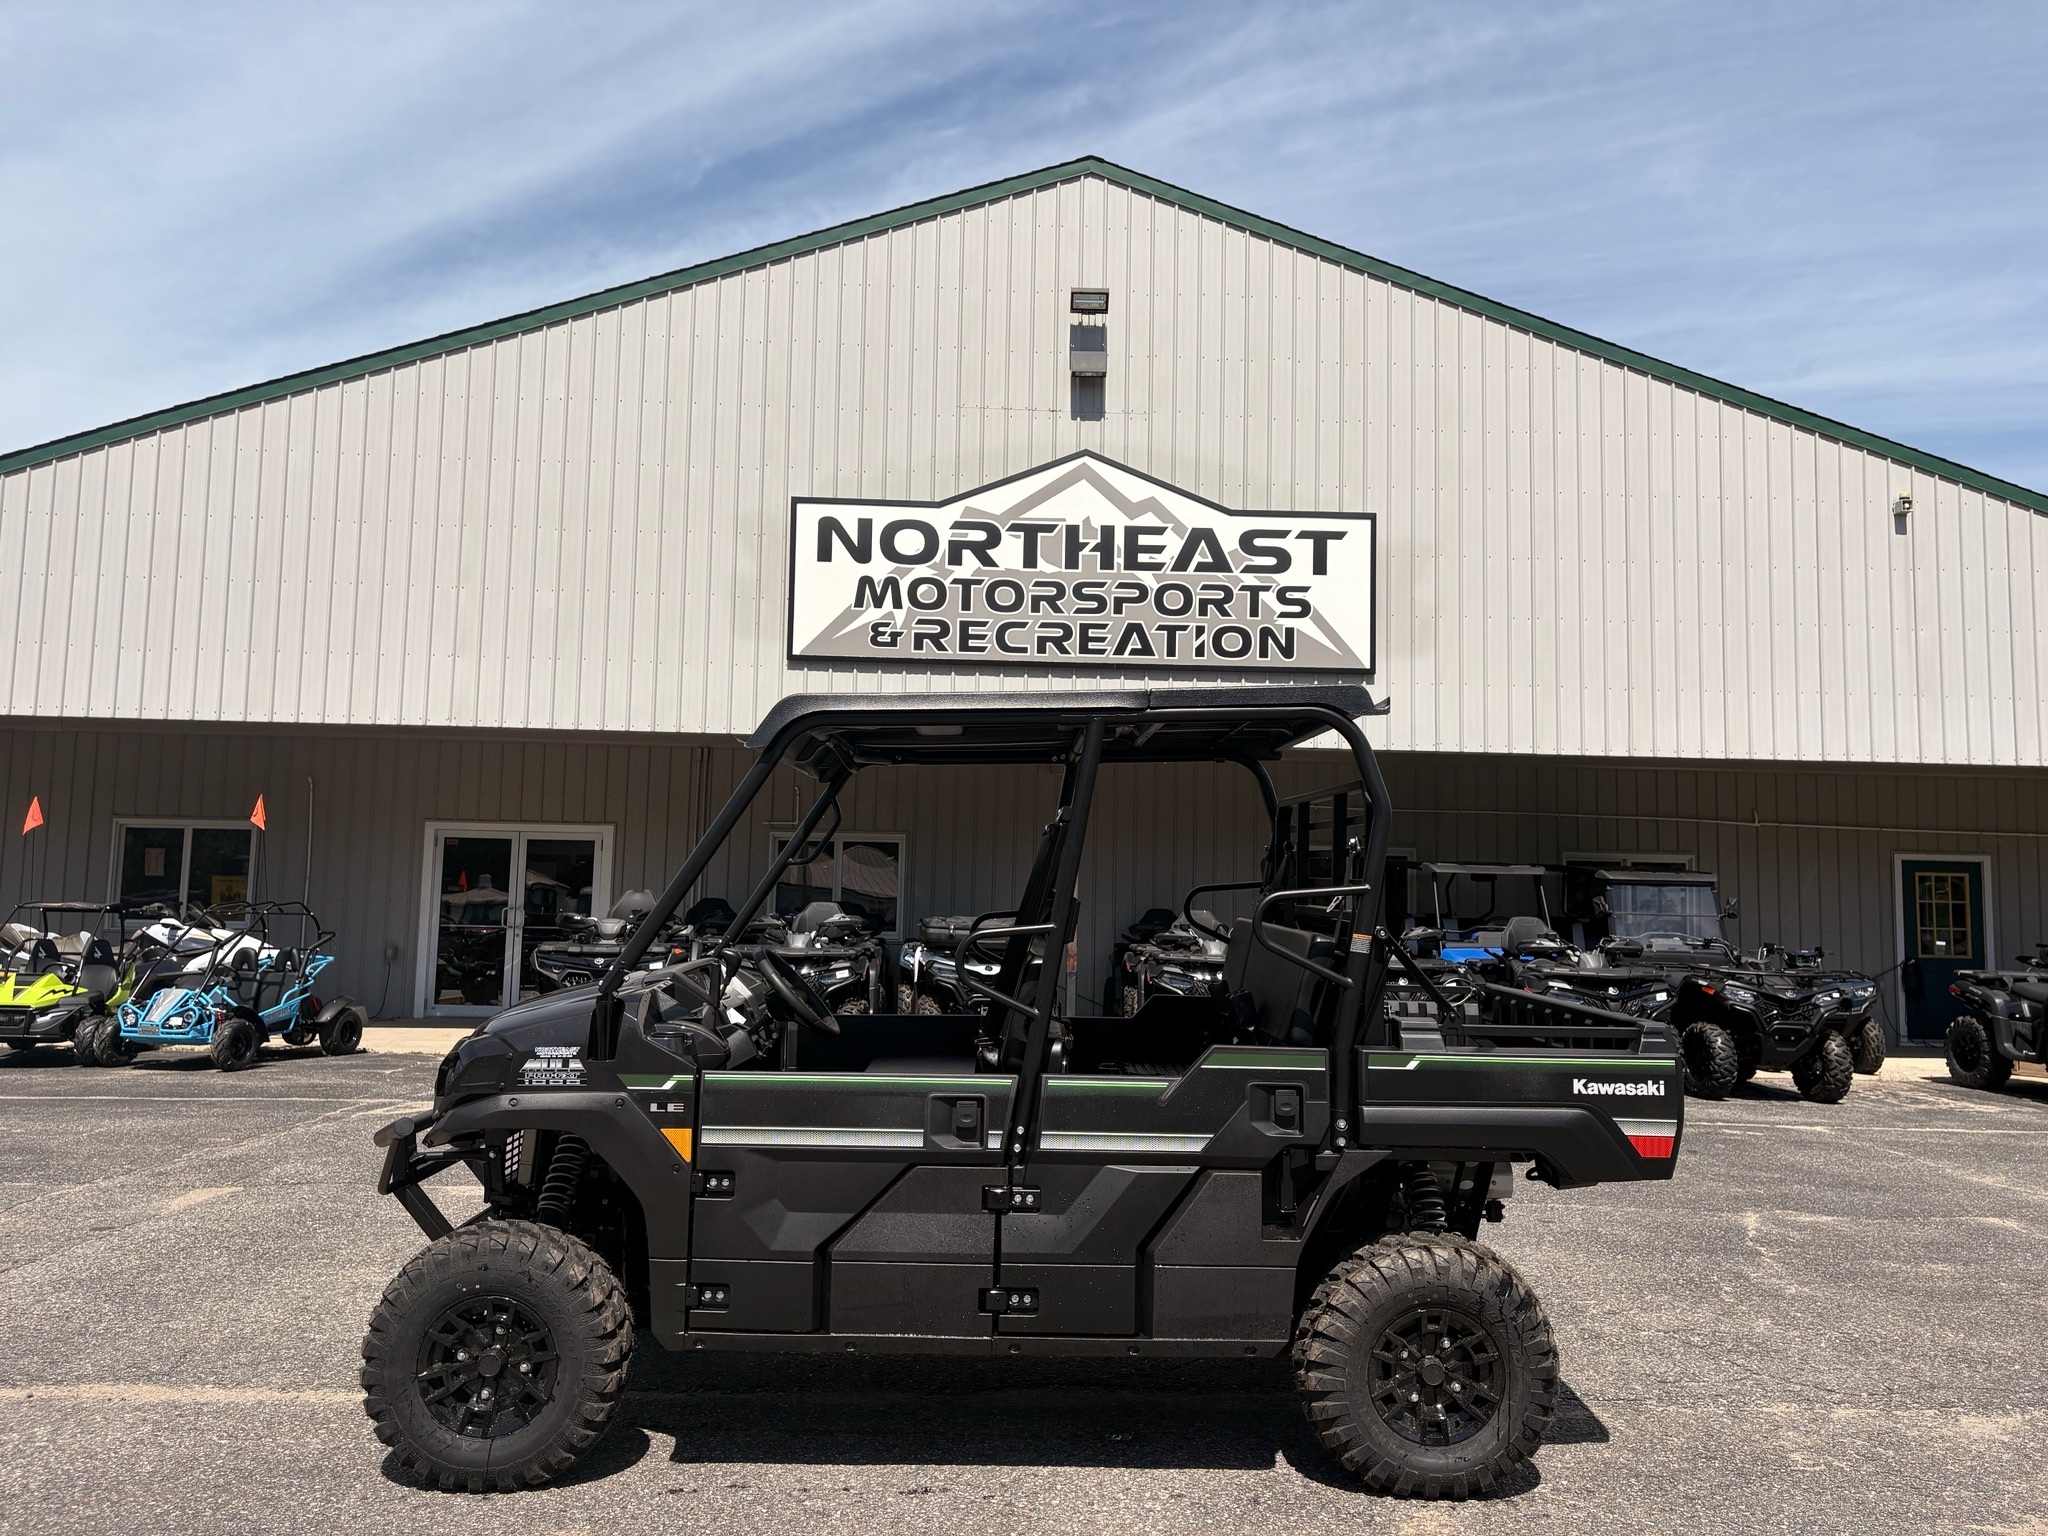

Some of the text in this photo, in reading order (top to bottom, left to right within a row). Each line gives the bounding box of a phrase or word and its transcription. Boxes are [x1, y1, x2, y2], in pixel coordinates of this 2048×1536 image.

[816, 517, 1348, 576] NORTHEAST
[853, 575, 1313, 620] MOTORSPORTS
[519, 1058, 587, 1073] MULE
[1572, 1078, 1665, 1096] Kawasaki
[649, 1102, 685, 1113] LE
